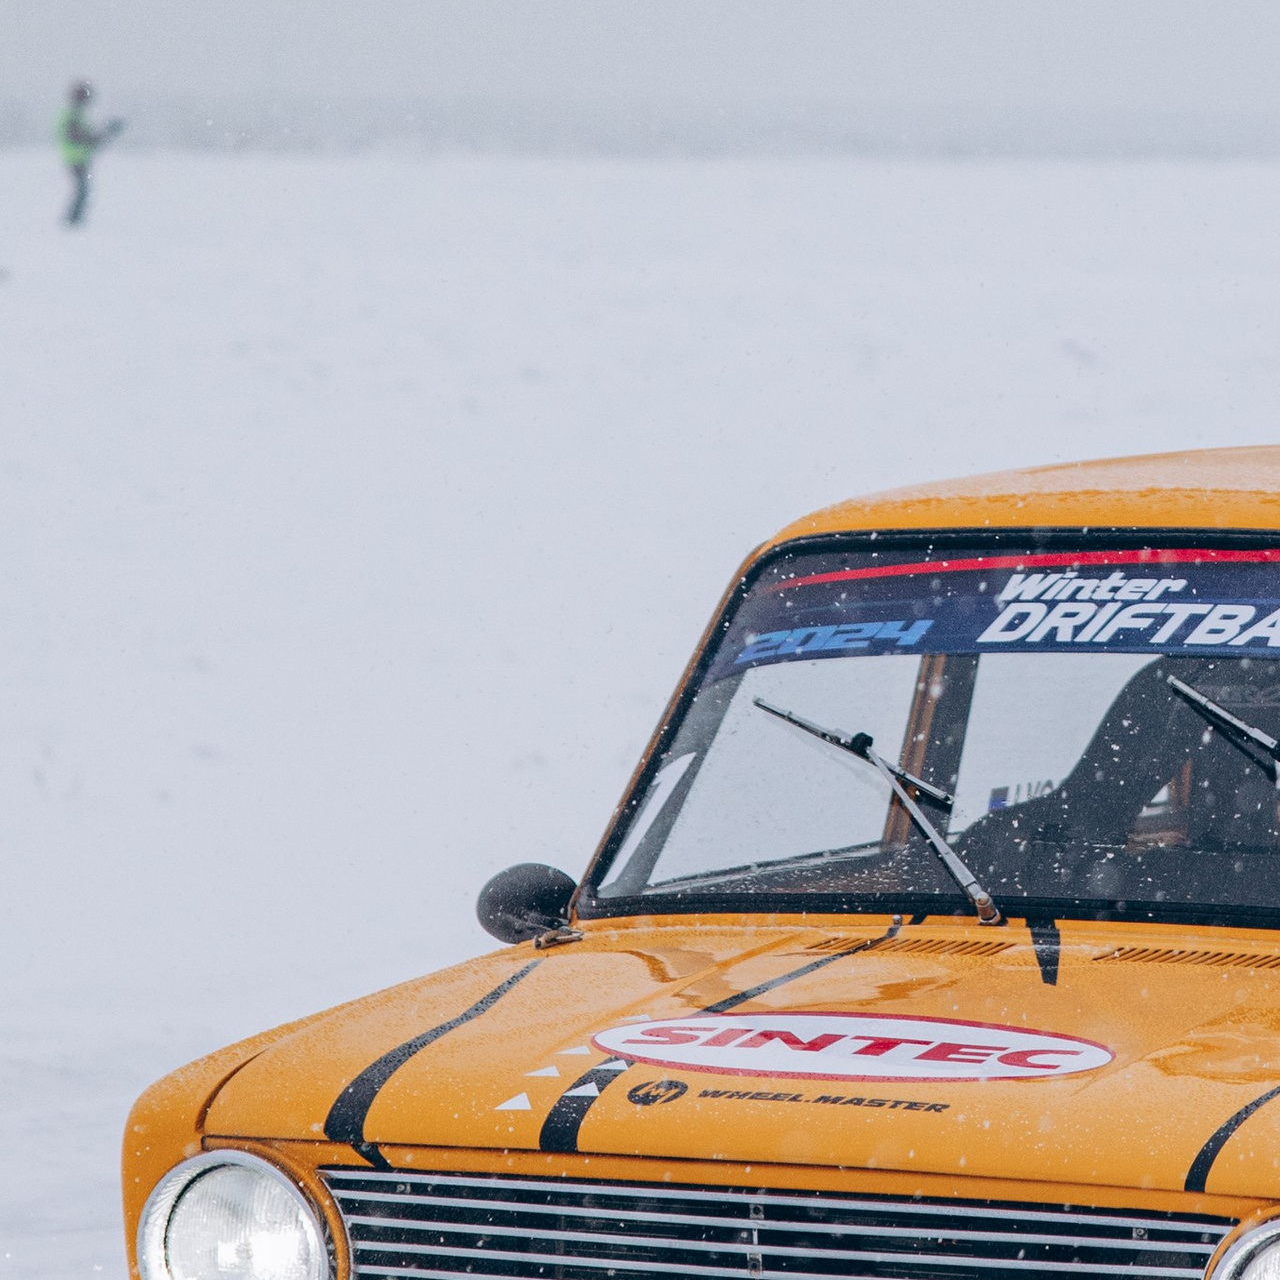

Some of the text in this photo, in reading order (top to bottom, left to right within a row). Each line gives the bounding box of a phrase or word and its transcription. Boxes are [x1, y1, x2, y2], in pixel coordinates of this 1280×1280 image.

[1000, 571, 1188, 602] Winter
[734, 618, 936, 666] 2024
[622, 1026, 1085, 1070] SINTEC
[697, 1088, 950, 1114] WHEEL.MASTER
